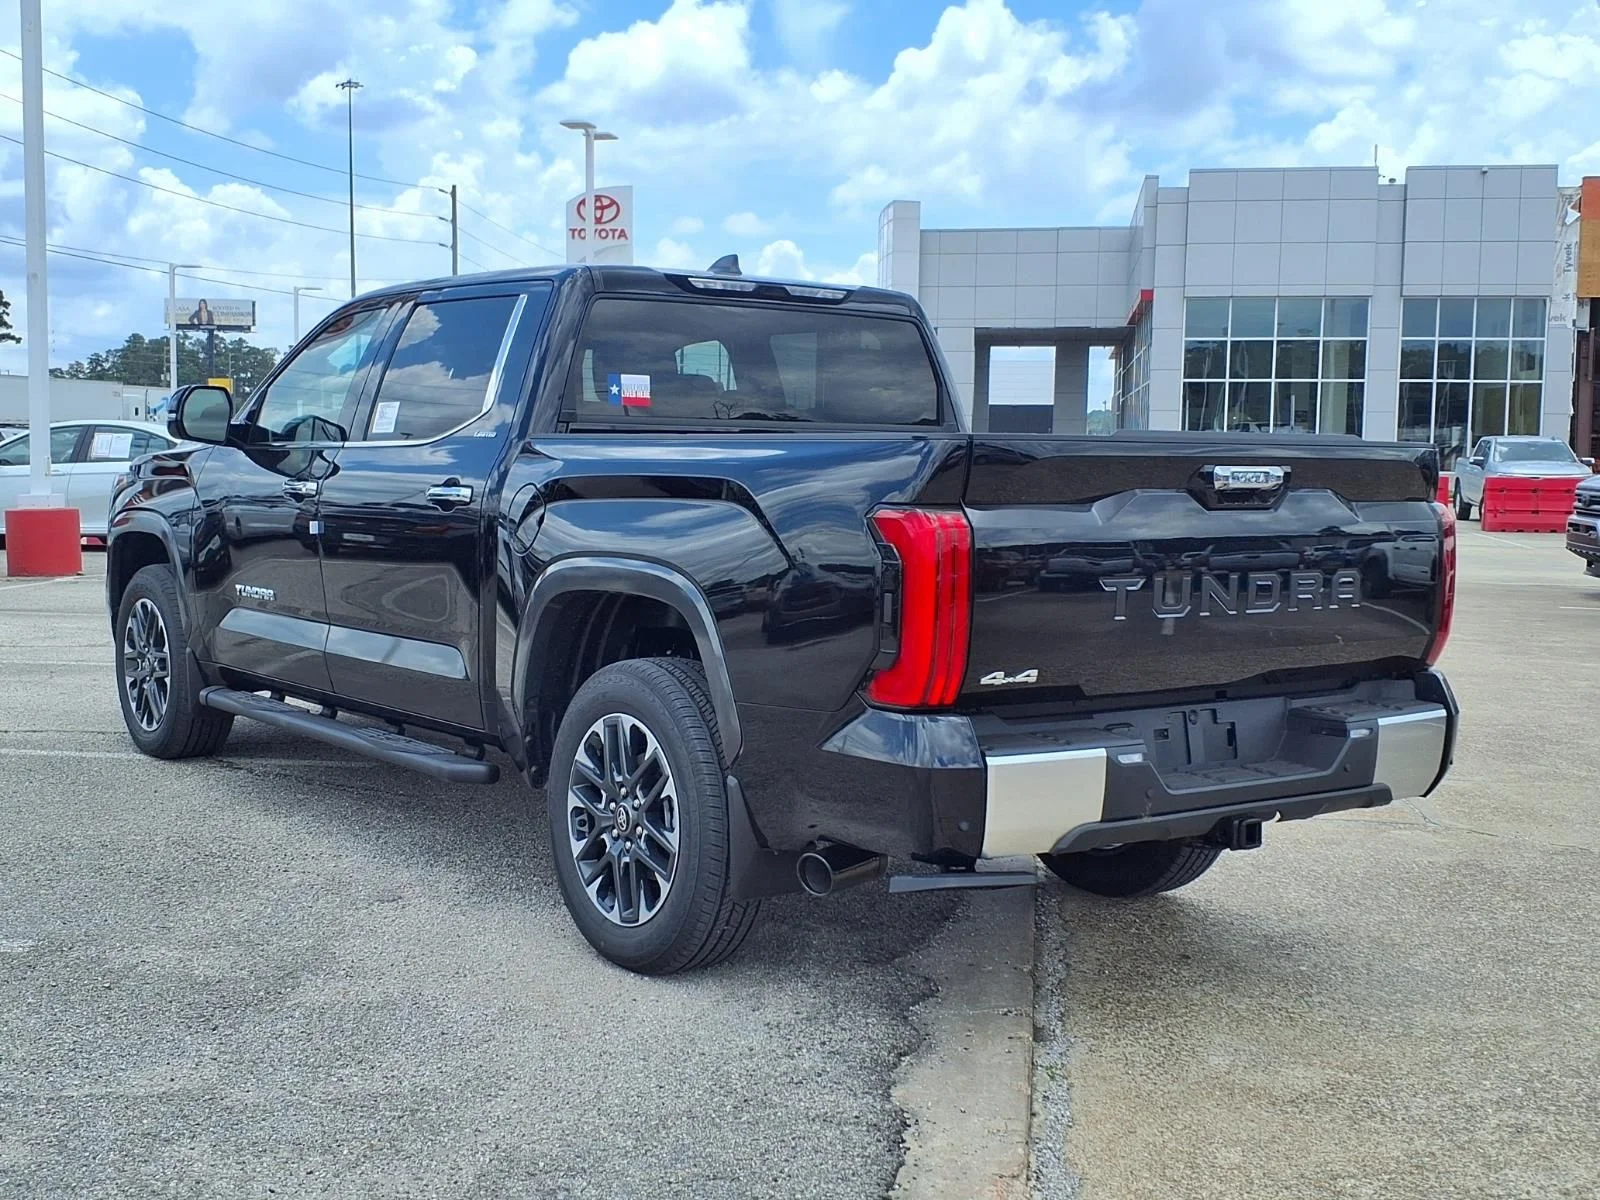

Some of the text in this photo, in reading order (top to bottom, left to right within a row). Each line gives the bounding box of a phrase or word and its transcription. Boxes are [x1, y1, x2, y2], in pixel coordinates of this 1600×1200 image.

[1563, 243, 1574, 272] Tyvek
[235, 584, 275, 601] TUNDRA
[1099, 569, 1362, 621] TUNDRA
